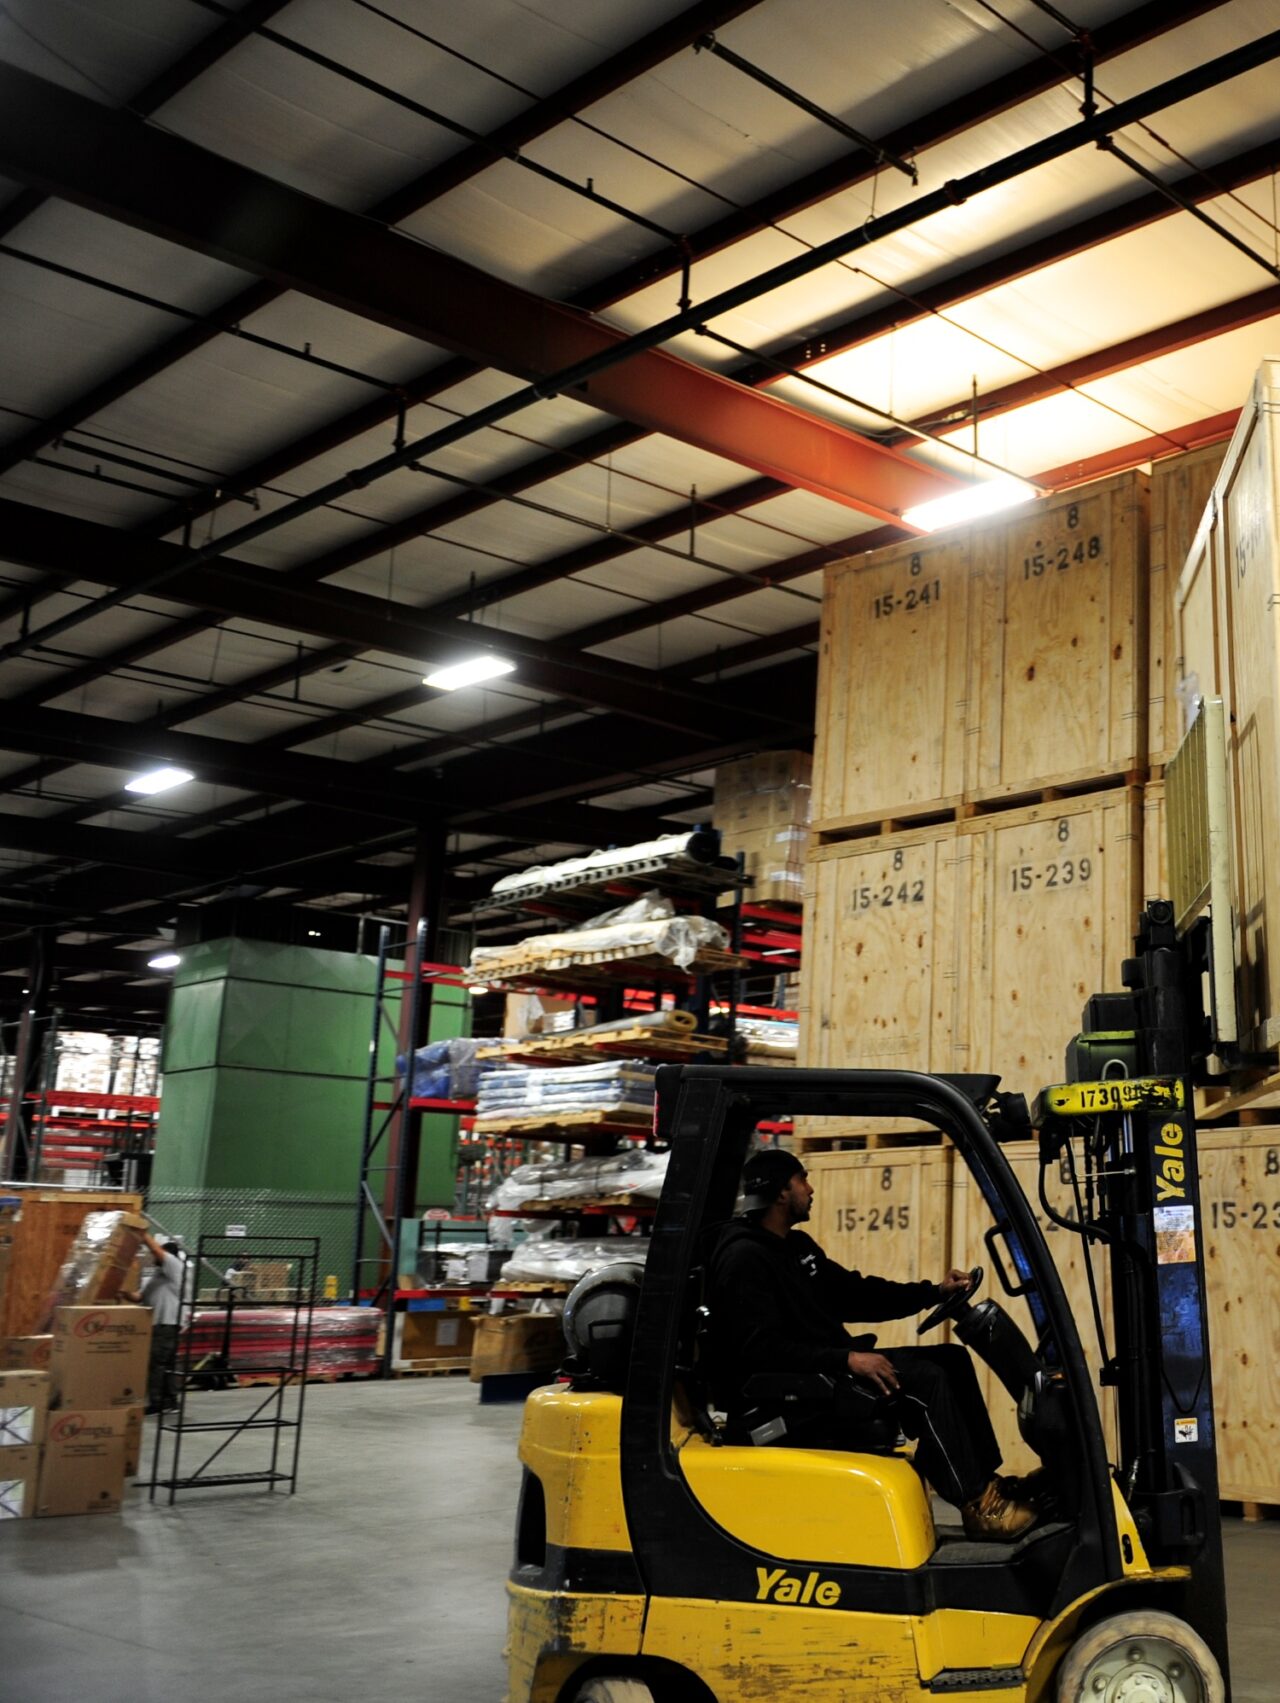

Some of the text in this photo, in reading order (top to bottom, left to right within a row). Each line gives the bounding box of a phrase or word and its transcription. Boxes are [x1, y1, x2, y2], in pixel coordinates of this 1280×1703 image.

[1066, 505, 1080, 530] 8
[910, 553, 922, 577] 8
[1023, 535, 1101, 581] 15-248
[874, 579, 942, 620] 15-241
[1057, 818, 1070, 843] 8
[893, 849, 904, 872] 8
[1010, 857, 1092, 892] 15-239
[851, 879, 925, 911] 15-242
[1153, 1122, 1186, 1202] Yale
[1266, 1148, 1280, 1175] 8
[881, 1167, 893, 1191] 8
[836, 1205, 911, 1233] 15-245
[755, 1566, 842, 1607] Yale
